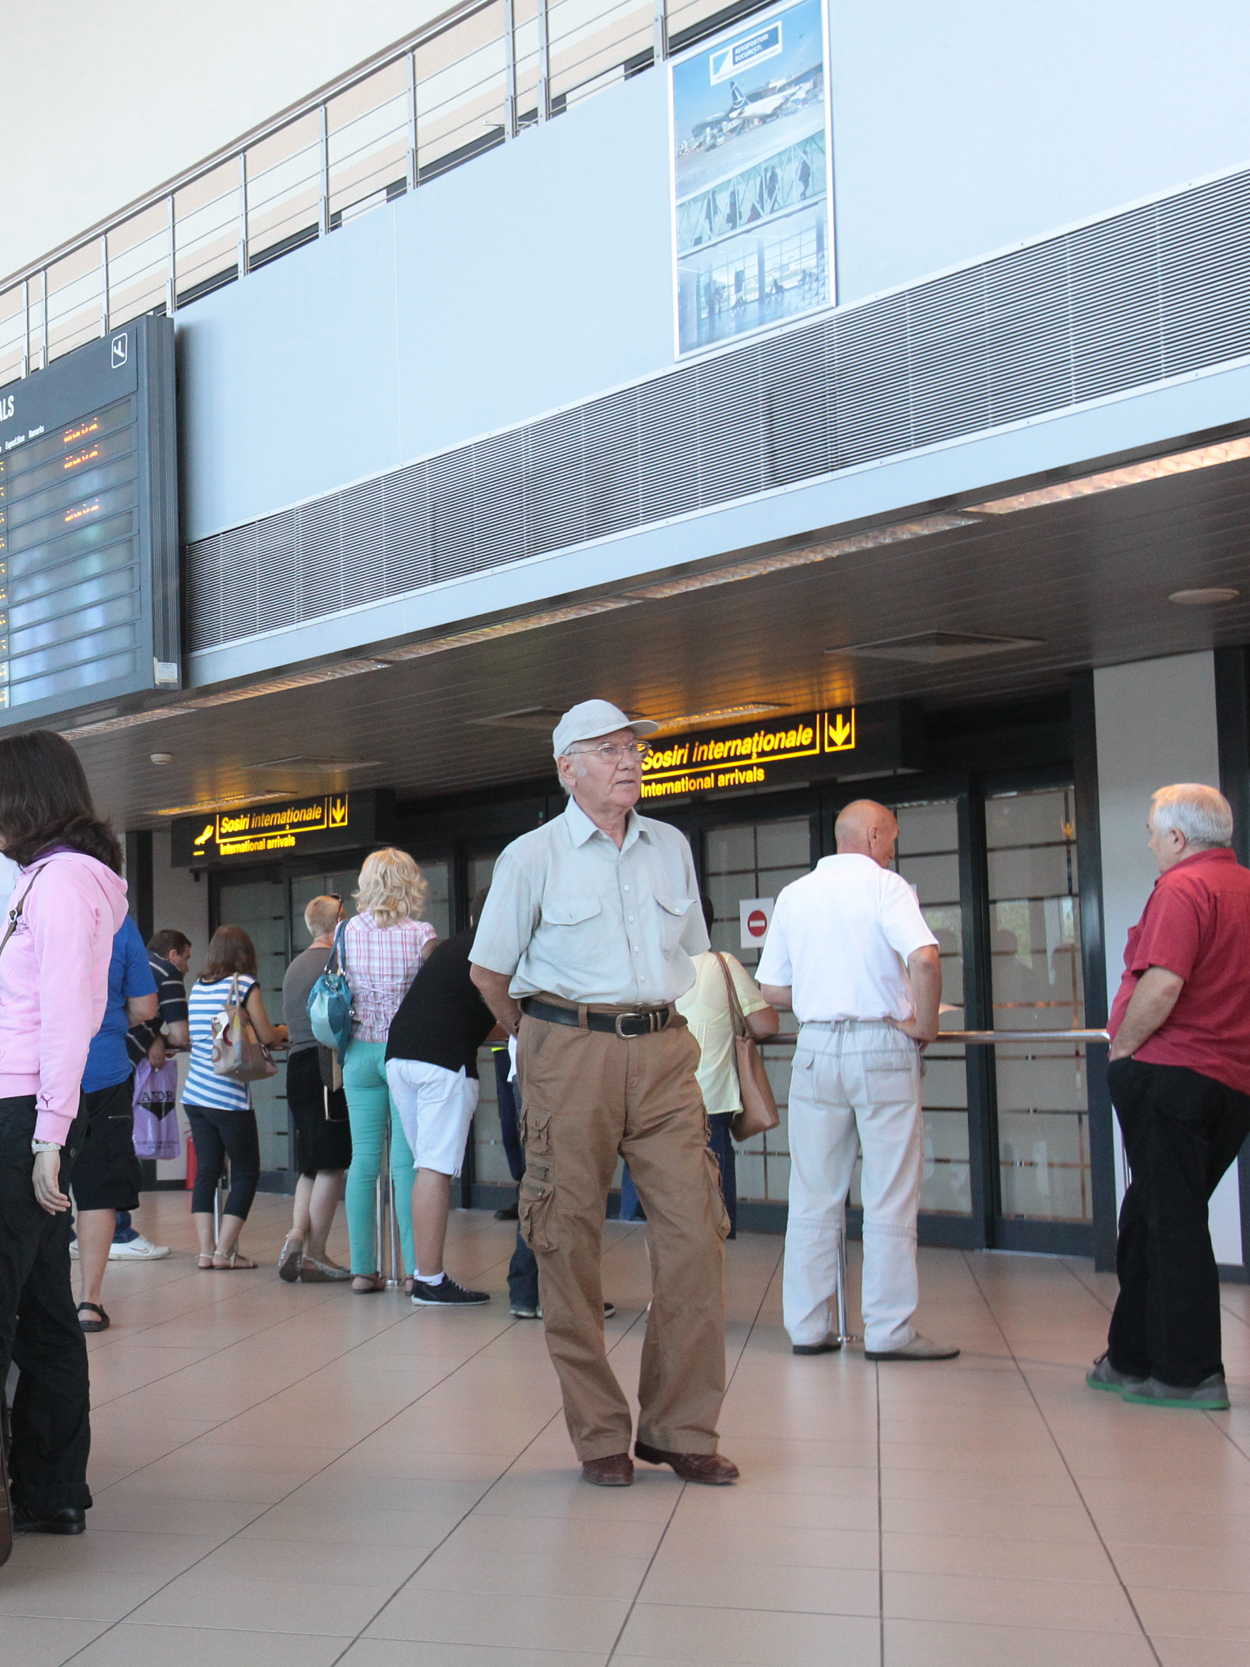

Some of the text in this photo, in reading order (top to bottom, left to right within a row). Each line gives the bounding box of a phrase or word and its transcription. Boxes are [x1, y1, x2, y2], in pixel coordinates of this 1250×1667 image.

[641, 743, 689, 772] Sosiri
[640, 766, 765, 799] International arrivals
[219, 813, 250, 834] Sosiri
[219, 834, 296, 856] International arrivals
[141, 1091, 175, 1101] ANDR
